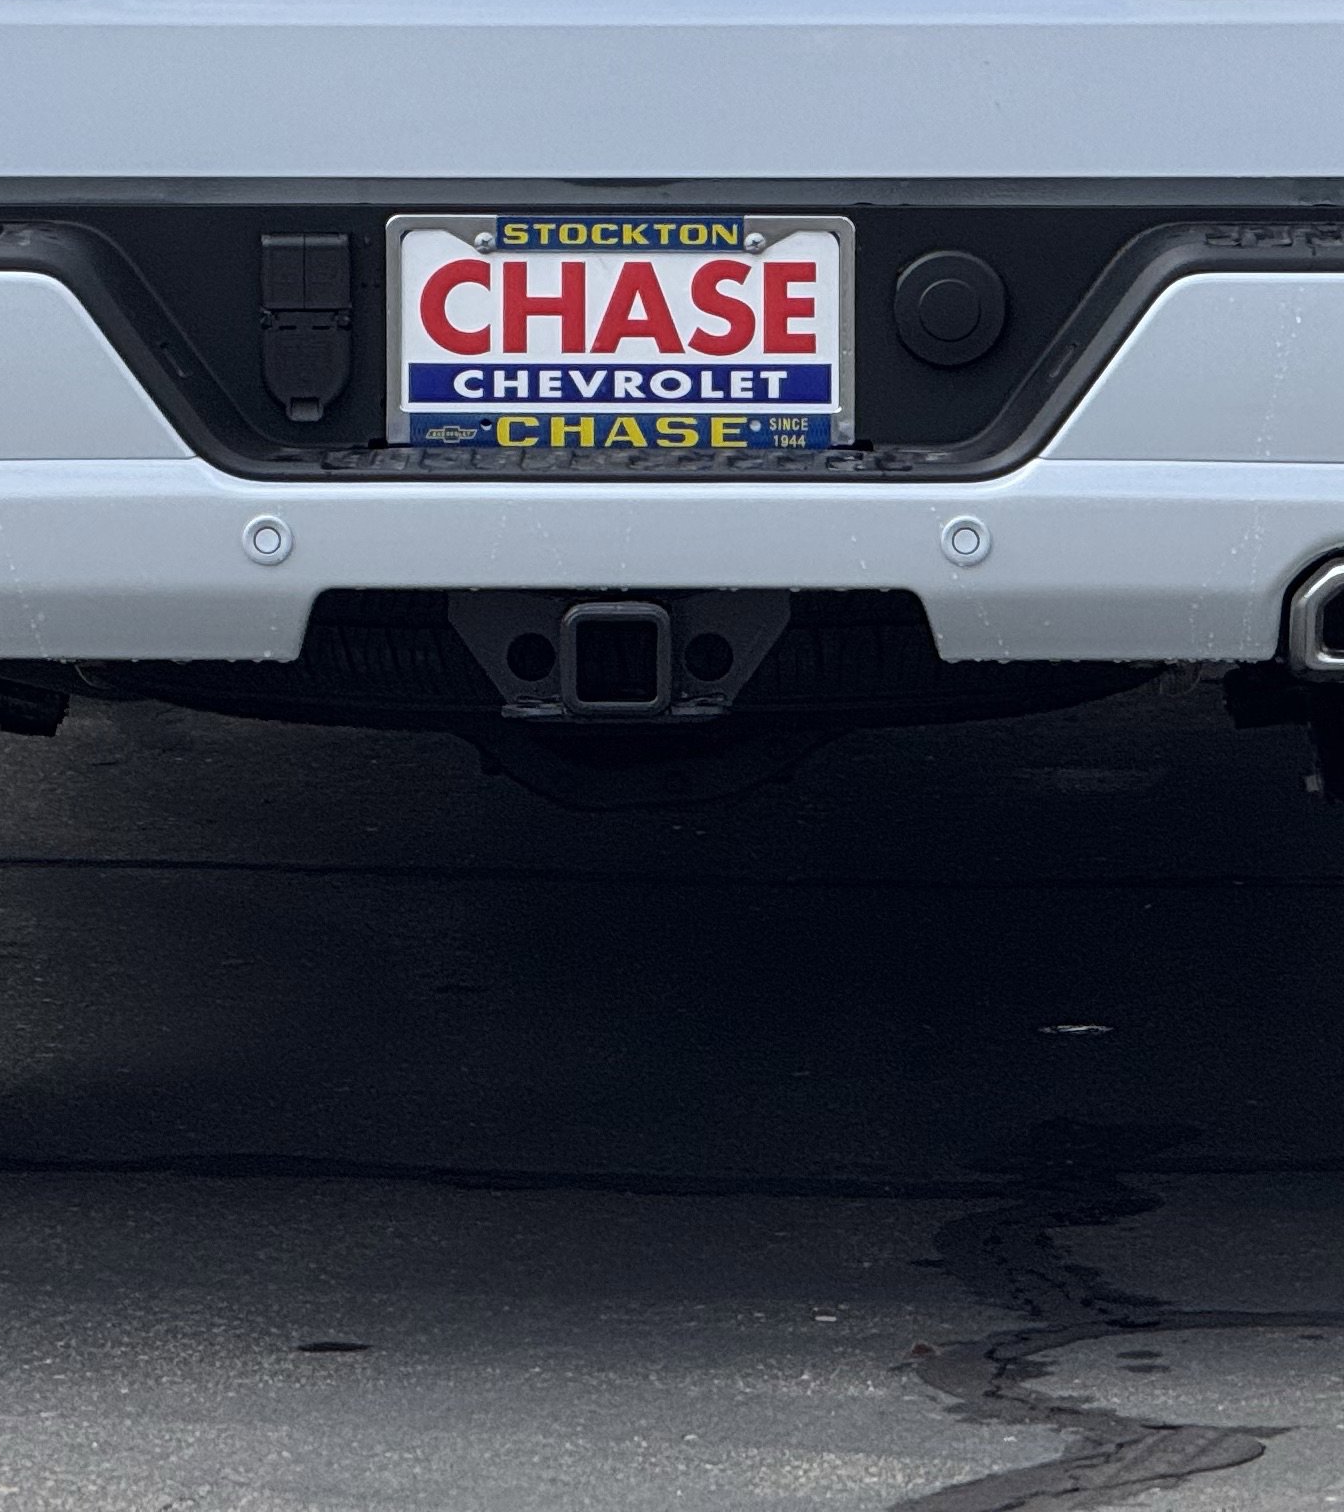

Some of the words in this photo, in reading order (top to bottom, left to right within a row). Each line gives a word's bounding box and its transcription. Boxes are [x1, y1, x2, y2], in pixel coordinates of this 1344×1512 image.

[502, 223, 739, 246] STOCKTON
[419, 258, 818, 357] CHASE
[452, 369, 789, 399] CHEVROLET
[496, 416, 749, 448] CHASE
[769, 417, 809, 431] SINCE
[773, 434, 806, 448] 1944
